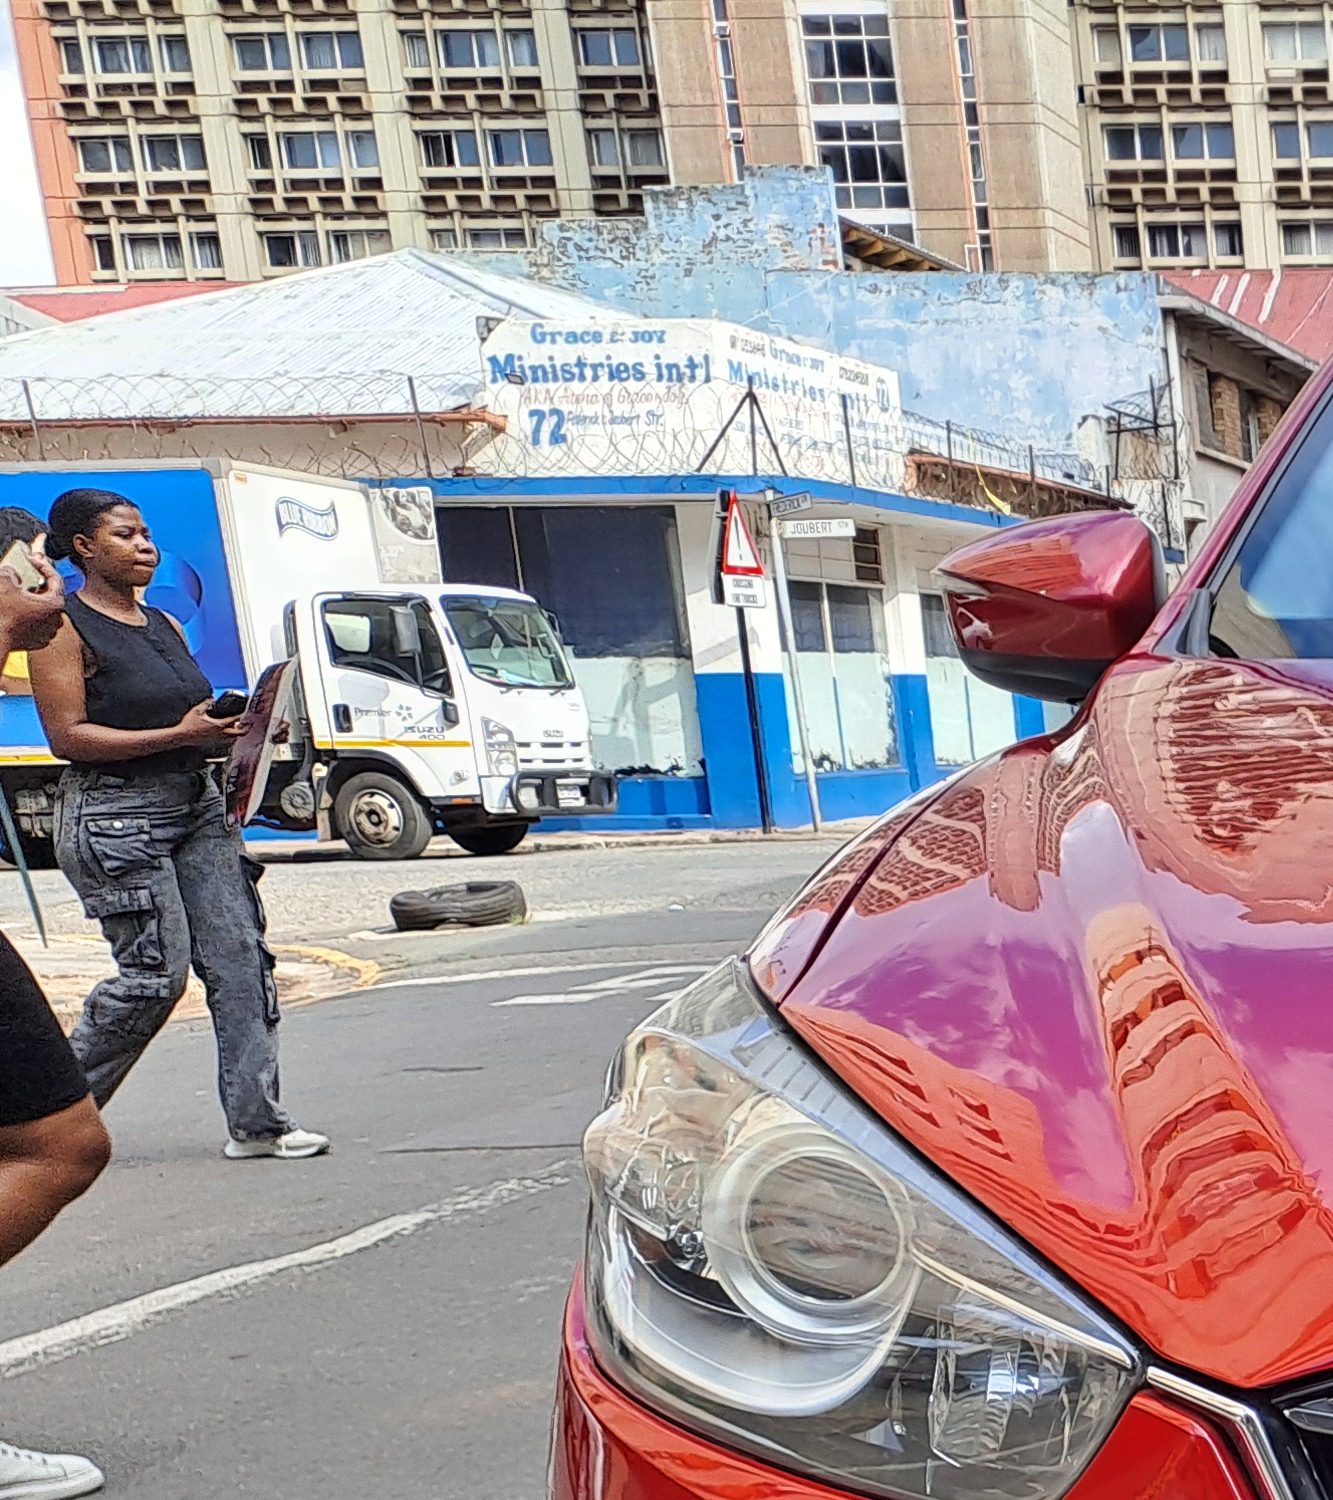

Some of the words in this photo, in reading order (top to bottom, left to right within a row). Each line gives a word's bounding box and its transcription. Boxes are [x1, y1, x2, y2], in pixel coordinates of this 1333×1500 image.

[530, 323, 603, 345] Grace
[486, 353, 647, 384] Ministries
[528, 408, 567, 446] 72
[790, 521, 832, 535] JOUBERT
[404, 725, 445, 734] ISUZU
